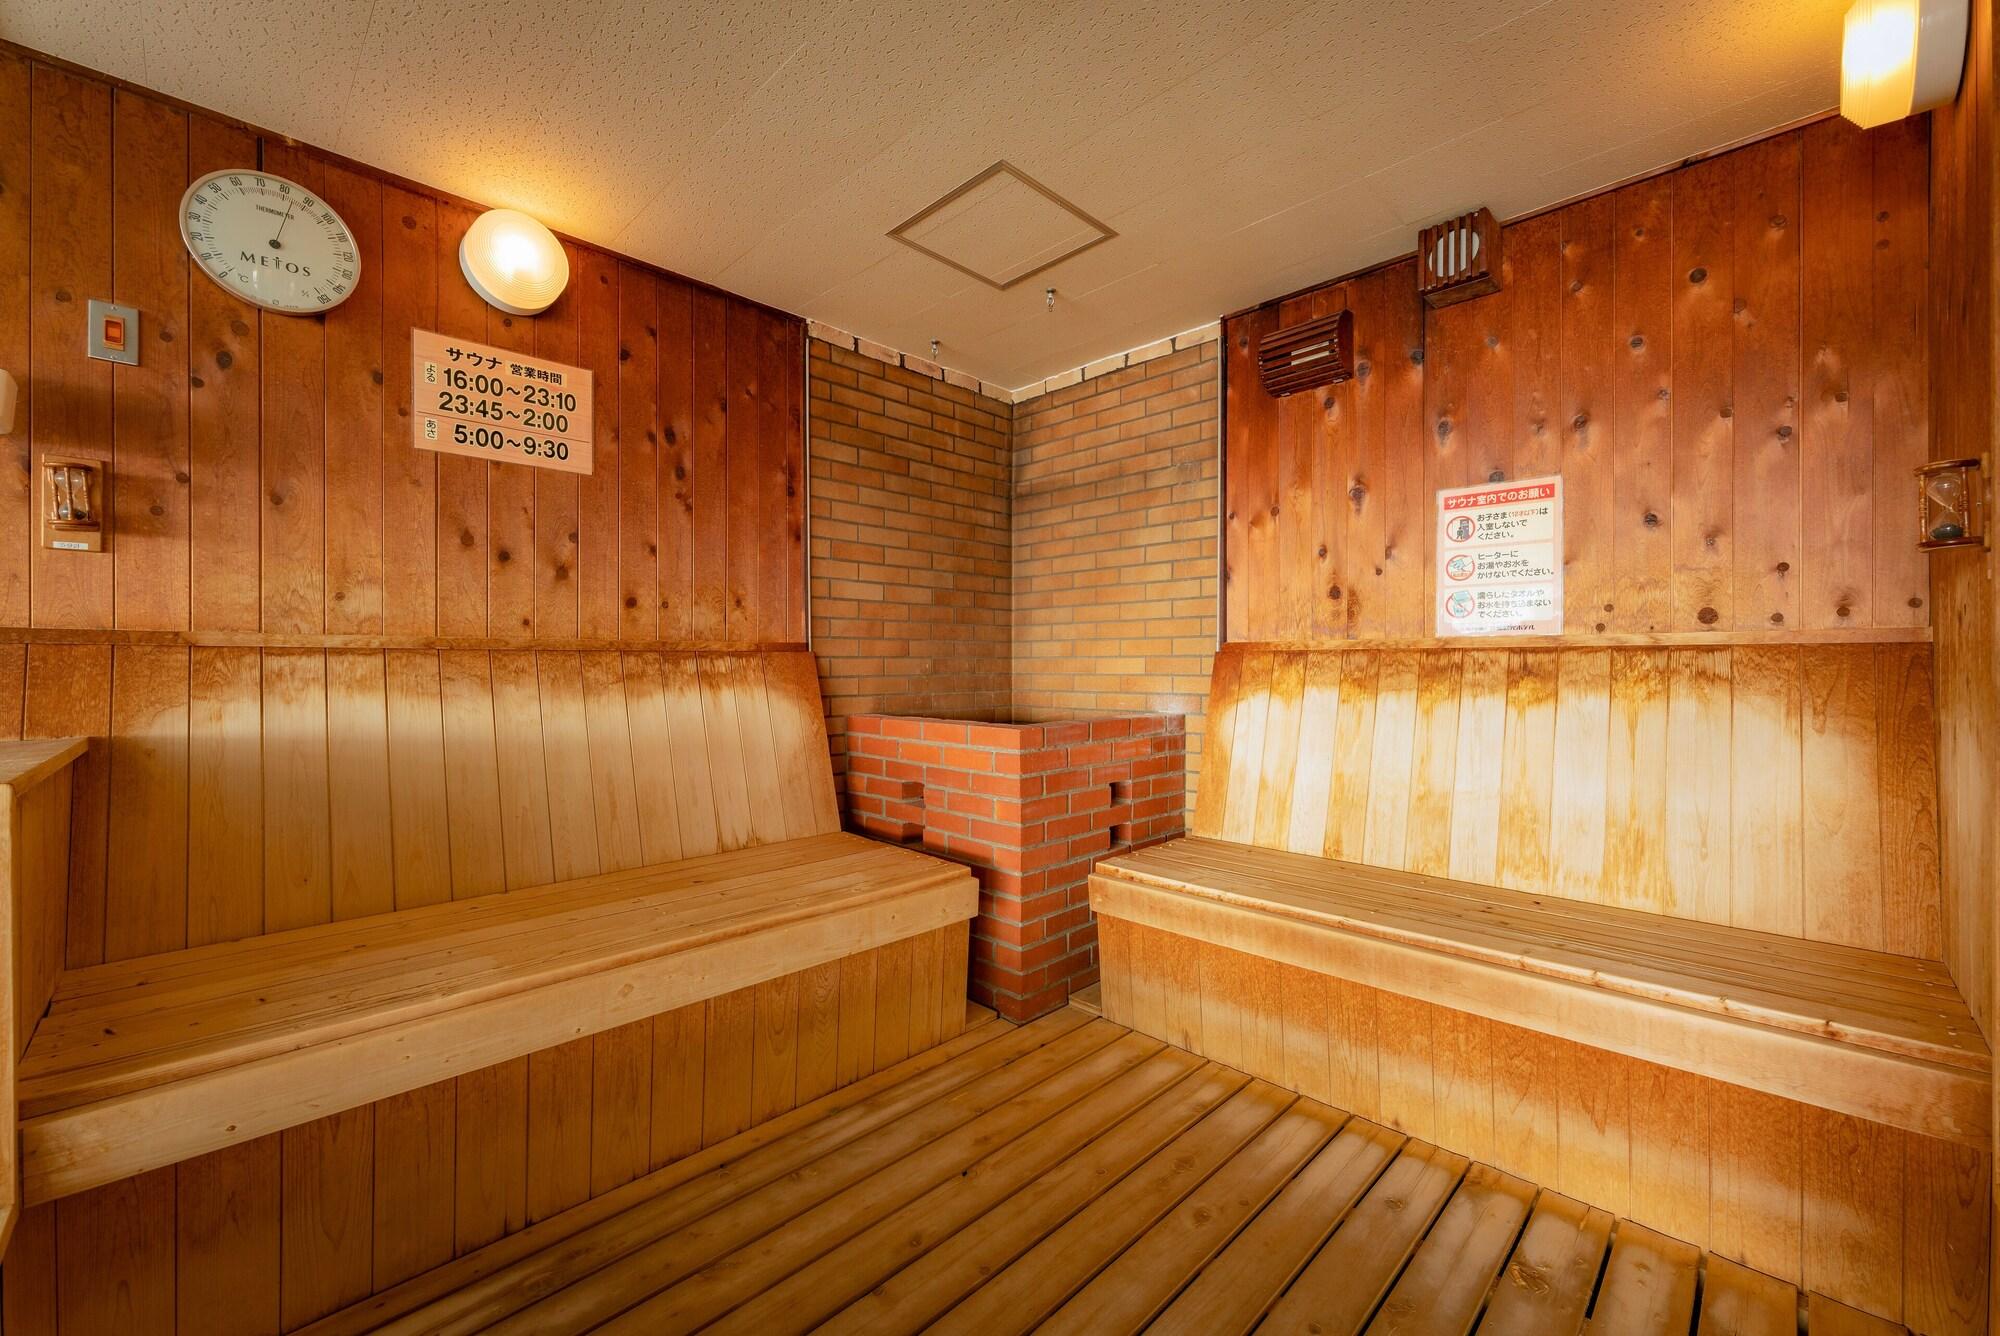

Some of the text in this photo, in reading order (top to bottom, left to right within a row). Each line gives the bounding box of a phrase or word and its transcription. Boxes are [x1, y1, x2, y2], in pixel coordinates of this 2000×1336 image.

[208, 182, 222, 193] 50
[229, 176, 242, 187] 60
[255, 177, 266, 188] 70
[279, 183, 290, 195] 80
[194, 194, 208, 206] 40
[302, 196, 314, 208] 90
[188, 211, 201, 222] 30
[321, 212, 336, 225] 100
[190, 231, 203, 242] 20
[335, 231, 348, 243] 110
[200, 252, 212, 261] 10
[342, 251, 354, 263] 120
[240, 250, 312, 277] METOS
[341, 268, 353, 281] 130
[332, 283, 346, 295] 140
[316, 295, 332, 305] 150
[445, 347, 563, 386] サウナ 営業時間
[1447, 487, 1550, 508] サウナ室内でのお願い
[1478, 550, 1519, 560] ヒーターに
